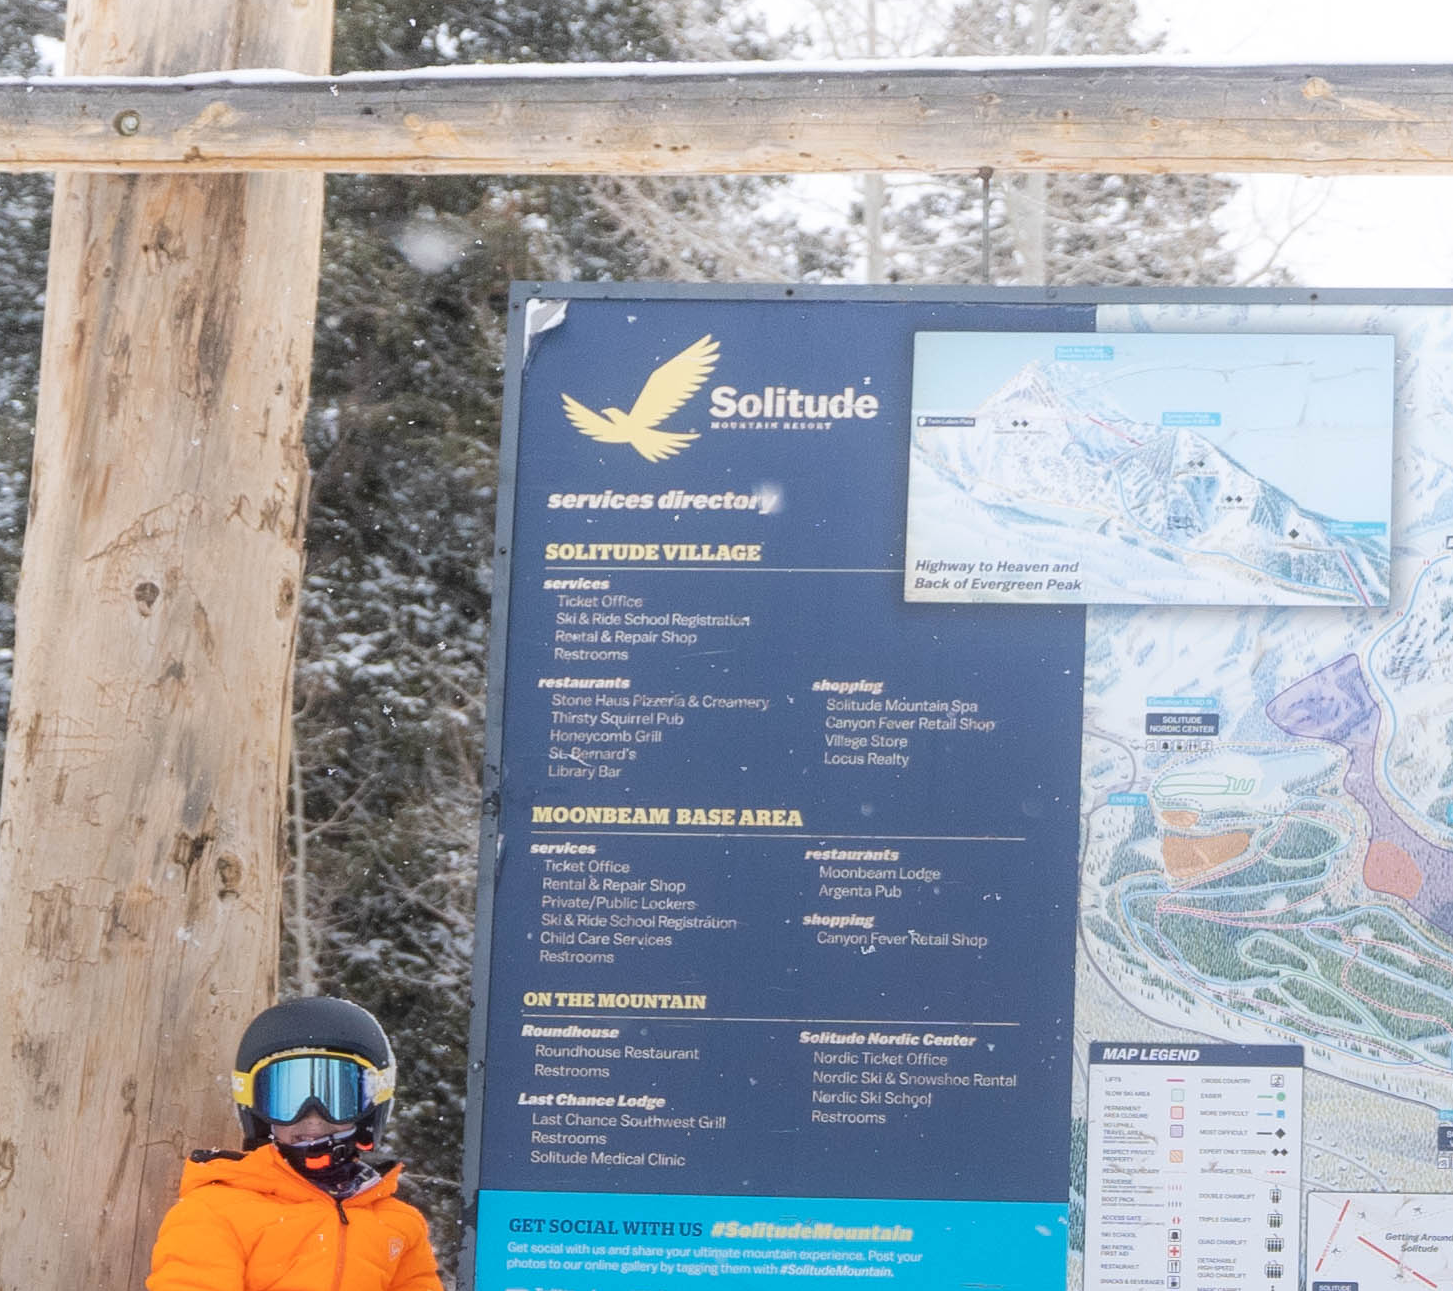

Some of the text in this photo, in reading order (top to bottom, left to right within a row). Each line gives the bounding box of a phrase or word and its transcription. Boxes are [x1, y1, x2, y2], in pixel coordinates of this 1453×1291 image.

[709, 385, 878, 419] Solitude
[710, 421, 832, 429] MOUNTAIN RESORT
[547, 489, 779, 514] services directory
[545, 543, 761, 561] SOLITUDE VILLAGE
[914, 559, 1079, 574] Highway to Heaven and
[543, 577, 609, 590] services
[914, 577, 1081, 592] Back of Evergreen Peak
[556, 594, 642, 608] Ticket Office
[556, 611, 750, 629] Ski & Ride School Registration
[554, 647, 628, 660] Restrooms
[538, 676, 630, 689] restaurants
[811, 678, 883, 695] shopping
[826, 697, 978, 716] Solitude Mountain Spa
[551, 710, 684, 729] Thirsty Squirrel Pub
[1162, 716, 1203, 724] SOLITUDE
[550, 727, 662, 745] Honeycomb Grill
[1149, 725, 1215, 733] NORDIC CENTER
[825, 733, 908, 750] Village Store
[548, 762, 622, 780] Library Bar
[531, 806, 803, 826] MOONBEAM BASE AREA
[804, 848, 899, 861] restaurants
[819, 865, 941, 883] Moonbeam Lodge
[523, 991, 706, 1009] ON THE MOUNTAIN
[521, 1024, 619, 1038] Roundhouse
[799, 1030, 976, 1046] Solitude Nordic Center
[535, 1043, 699, 1060] Roundhouse Restaurant
[1102, 1047, 1200, 1061] MAP LEGEND
[517, 1092, 665, 1110] Last Chance Lodge
[530, 1149, 685, 1166] Solitude Medical Clinic
[508, 1217, 702, 1236] GET SOCIAL WITH US
[710, 1220, 913, 1243] #SolitudeMountain
[1385, 1232, 1420, 1243] Getting
[1400, 1243, 1438, 1252] Solitude
